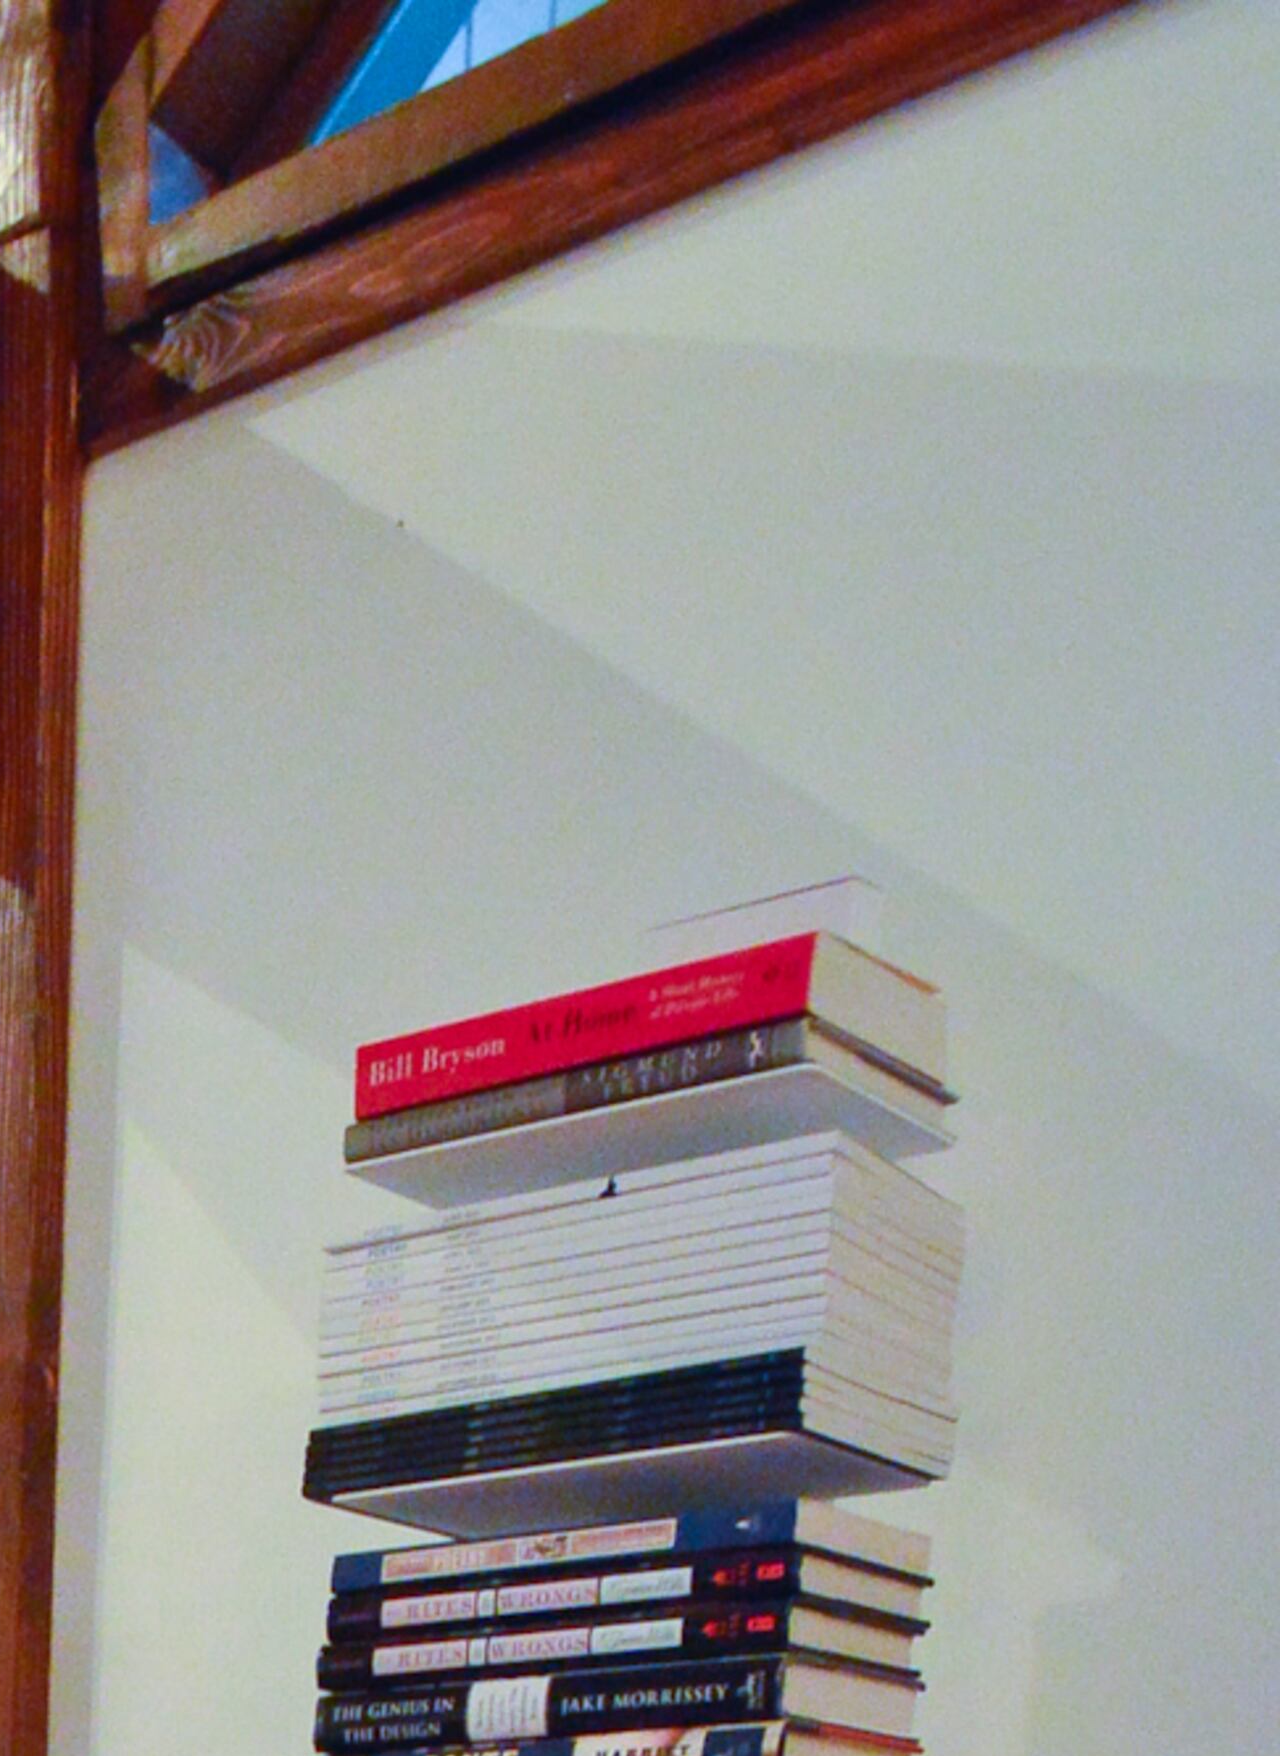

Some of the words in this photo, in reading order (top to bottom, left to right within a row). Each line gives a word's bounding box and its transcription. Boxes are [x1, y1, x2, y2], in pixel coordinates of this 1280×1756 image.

[369, 1054, 413, 1087] Bill
[422, 1038, 506, 1074] Bryson
[406, 1597, 473, 1622] RITES
[498, 1583, 599, 1612] WRONGS
[398, 1644, 463, 1668] RITES
[491, 1633, 589, 1660] WRONGS
[332, 1704, 363, 1722] THE
[367, 1699, 429, 1719] GENIUS
[434, 1697, 456, 1714] IN
[561, 1696, 605, 1717] JAKE
[613, 1683, 730, 1708] MORRISSEY
[344, 1727, 373, 1744] THE
[379, 1723, 440, 1742] DESIGN
